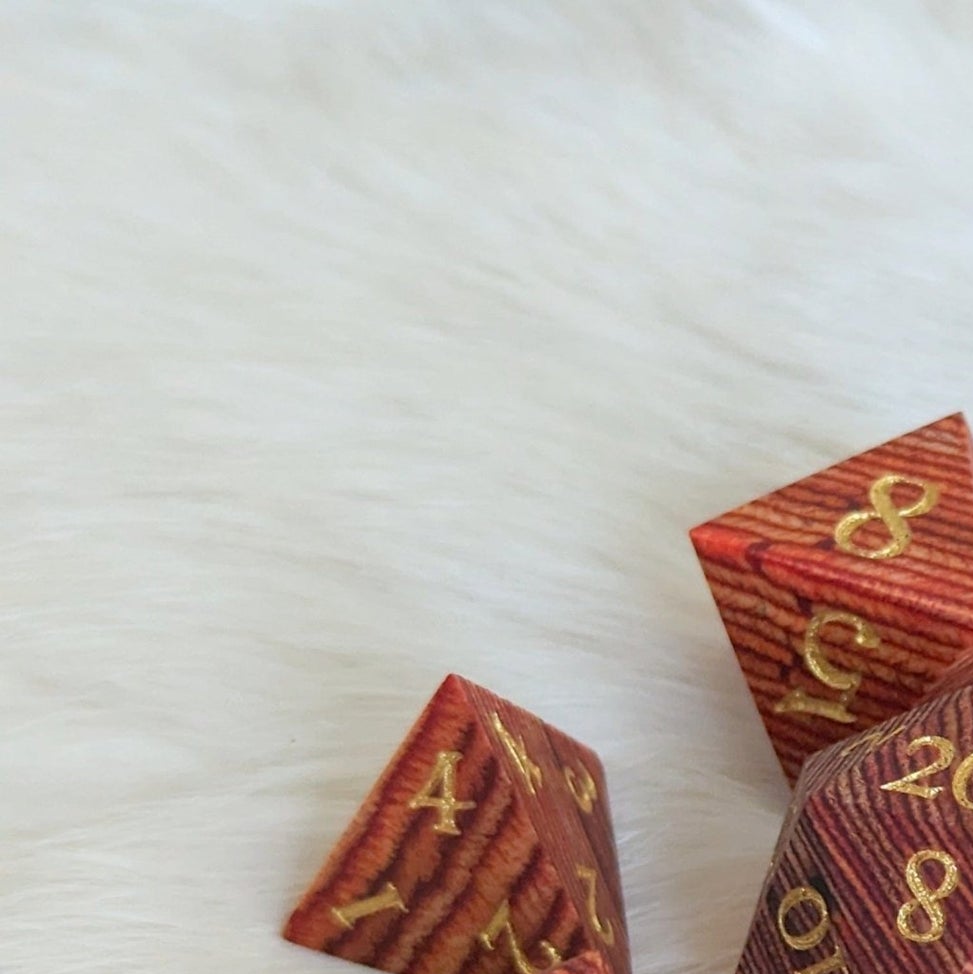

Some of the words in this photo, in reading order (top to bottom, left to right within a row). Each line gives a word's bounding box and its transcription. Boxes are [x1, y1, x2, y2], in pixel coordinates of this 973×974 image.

[834, 473, 942, 560] 8
[772, 608, 880, 724] 5
[408, 750, 477, 836] 4
[330, 880, 409, 930] 1
[896, 849, 959, 943] 8
